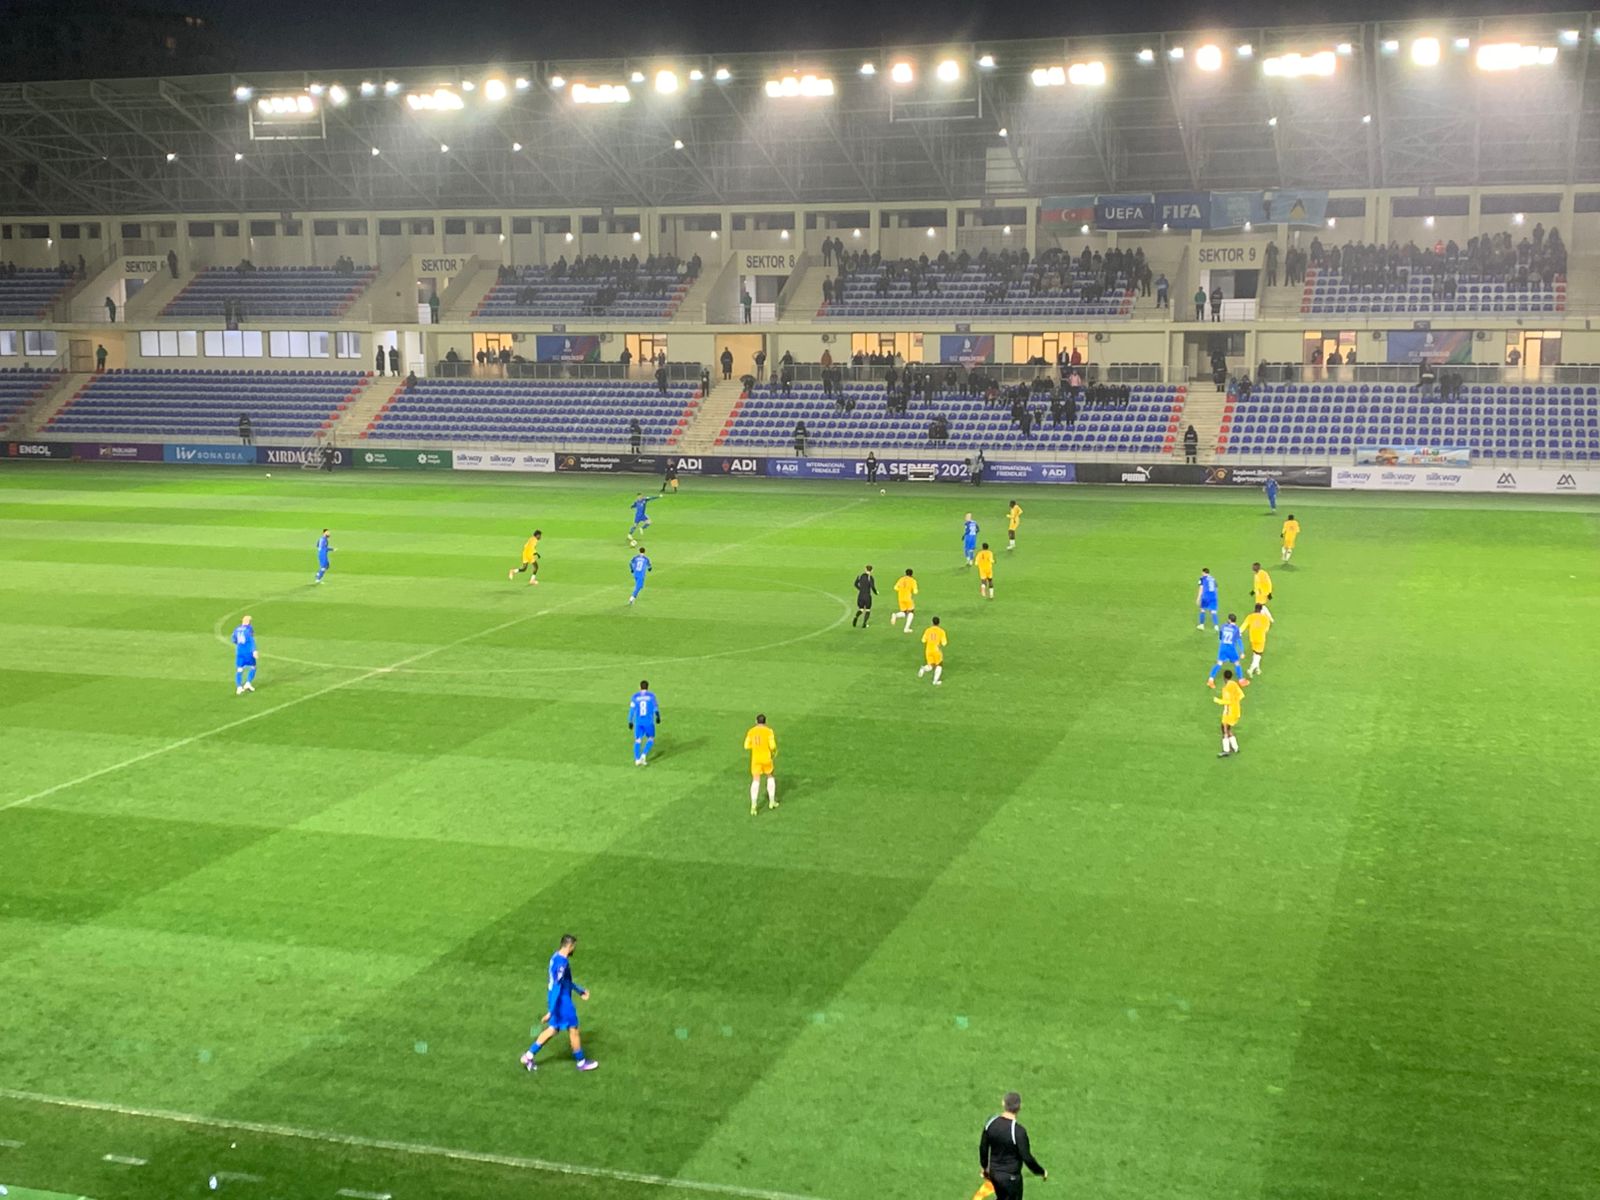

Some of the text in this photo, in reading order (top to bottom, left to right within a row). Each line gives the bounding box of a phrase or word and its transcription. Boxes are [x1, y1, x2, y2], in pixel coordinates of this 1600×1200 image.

[1105, 207, 1144, 219] UEFA
[1162, 204, 1201, 219] FIFA
[1199, 247, 1257, 262] SEKTOR 9
[125, 261, 157, 273] SEKTOR
[421, 259, 457, 271] SEKTOR
[746, 254, 796, 268] SEKTOR 8
[19, 445, 50, 454] ENSOL
[677, 459, 702, 470] ADI
[731, 460, 756, 471] ADI
[782, 464, 798, 472] ADI
[855, 463, 888, 475] FIA
[1048, 469, 1066, 477] ADI
[1121, 473, 1146, 482] PUMA
[639, 700, 647, 716] 8
